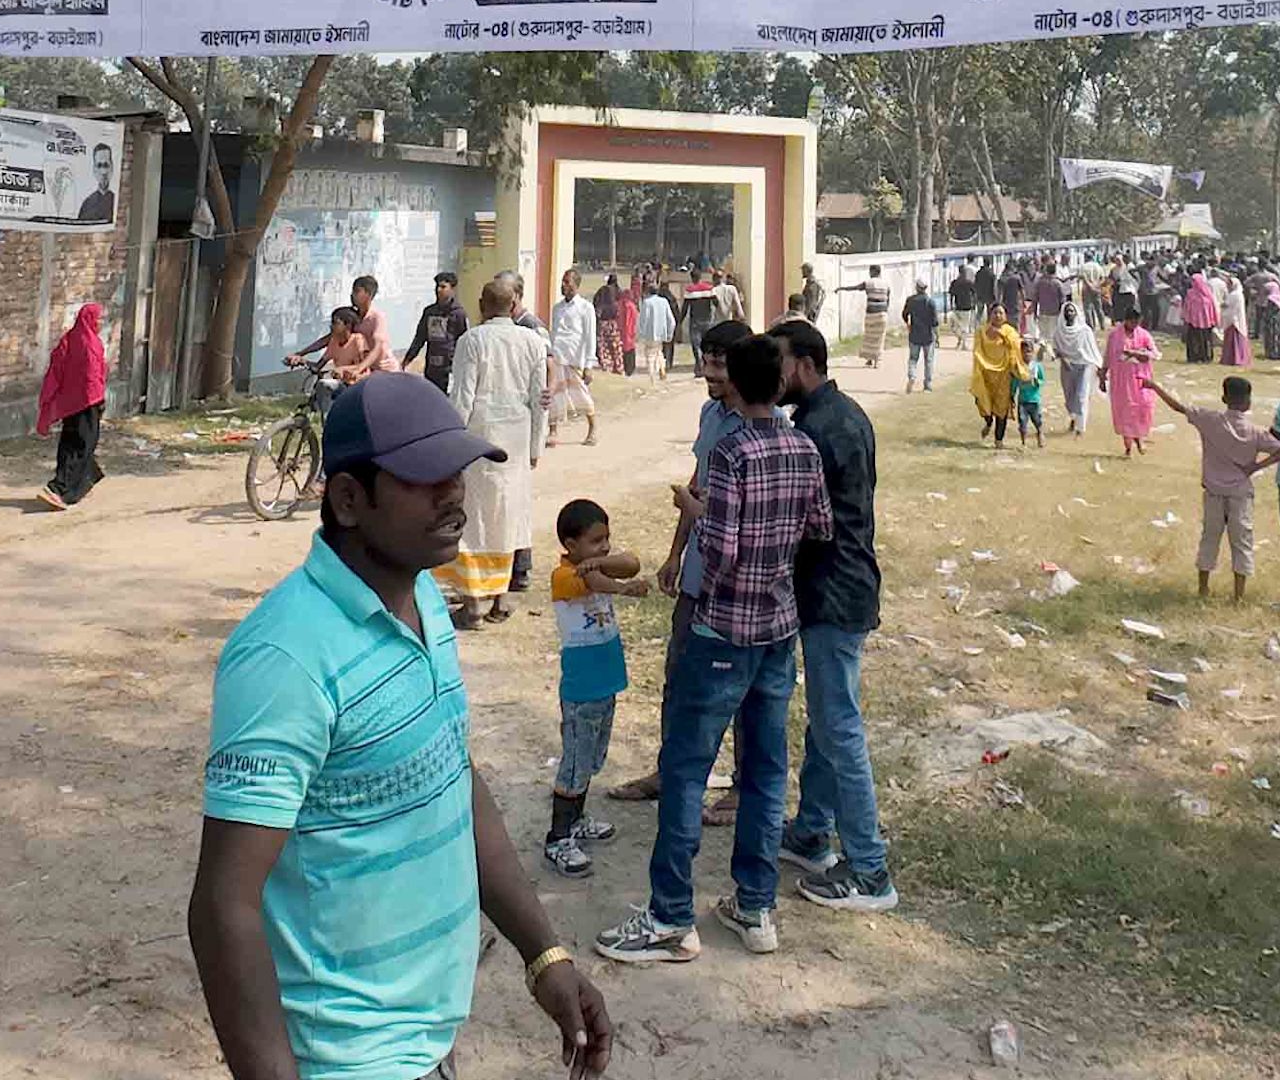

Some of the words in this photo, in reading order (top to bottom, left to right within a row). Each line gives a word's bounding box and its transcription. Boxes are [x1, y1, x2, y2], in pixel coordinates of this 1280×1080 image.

[444, 19, 480, 41] নাটোর
[757, 22, 817, 47] বাংলাদেশ
[821, 22, 888, 45] জামায়াতে
[891, 14, 945, 41] ইসলামী
[1034, 8, 1077, 32] নাটোর
[200, 28, 261, 48] বাংলাদেশ
[264, 27, 322, 47] জামায়াতে
[324, 19, 370, 44] ইসলামী
[235, 755, 277, 777] YOUTH
